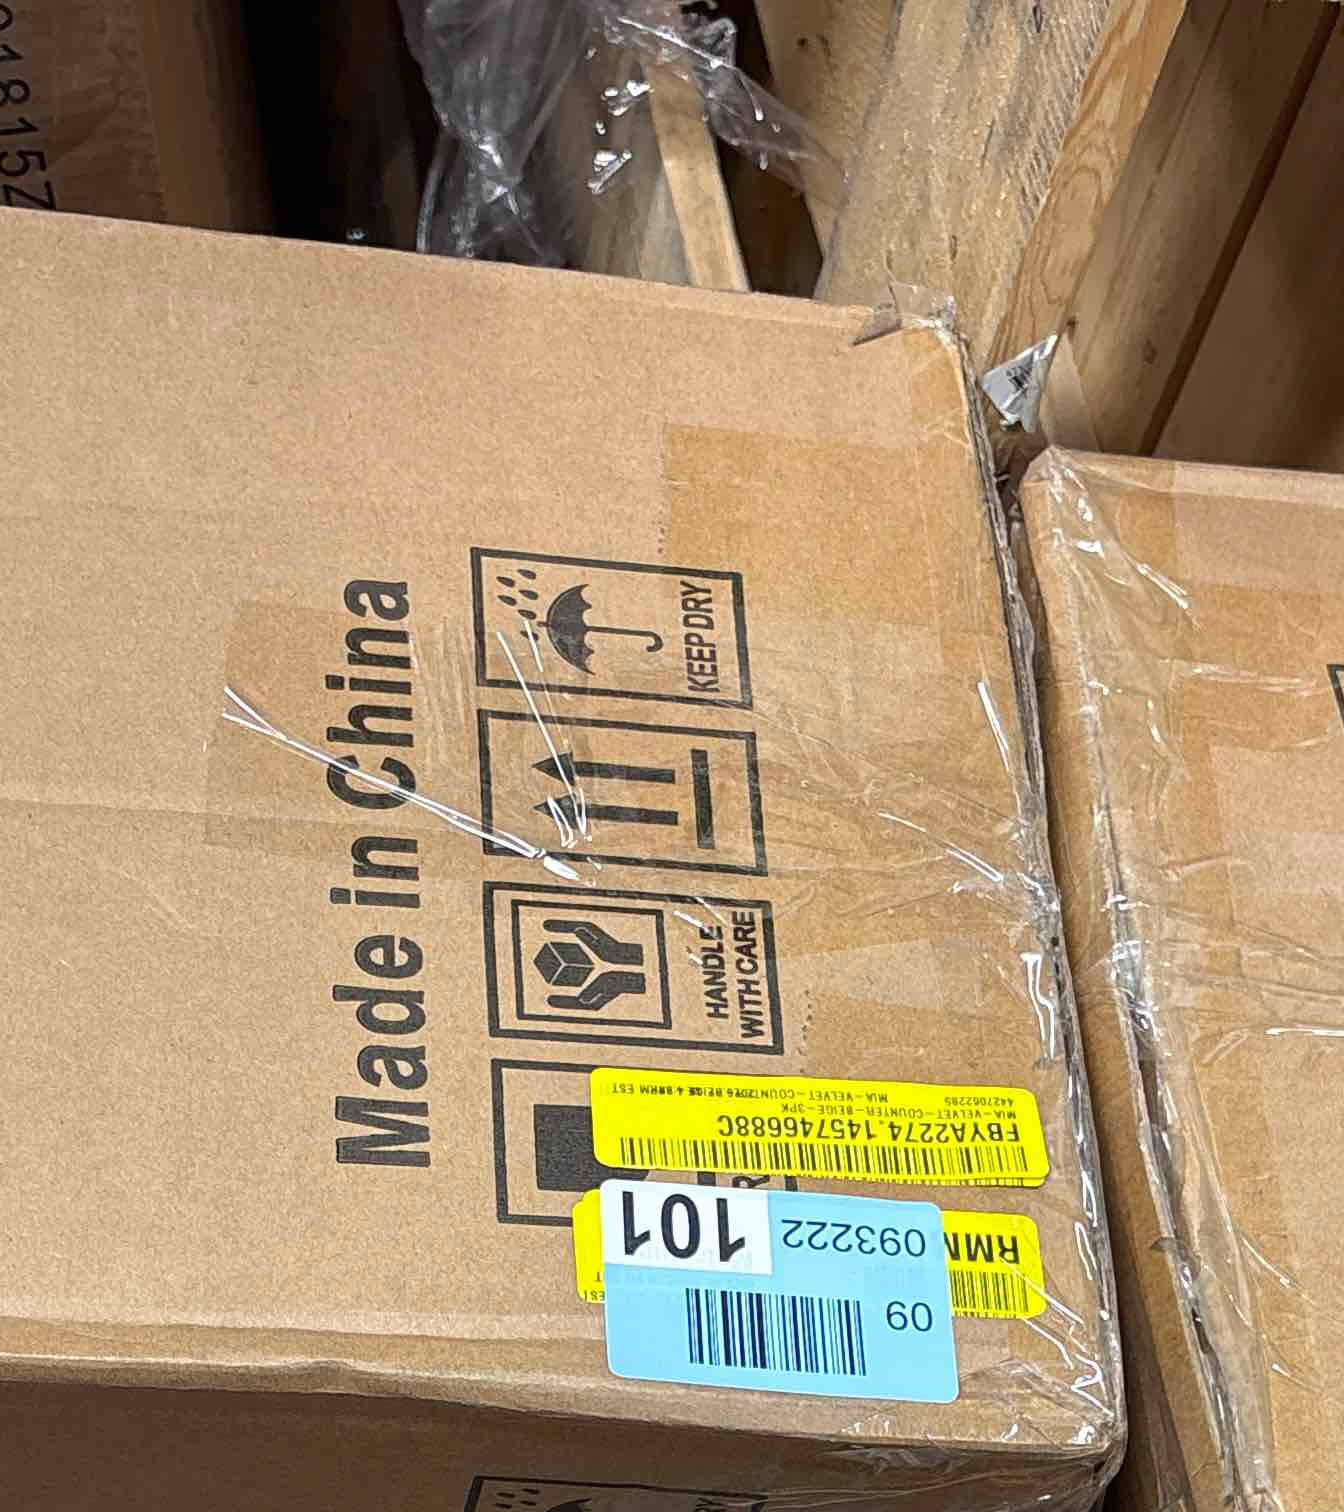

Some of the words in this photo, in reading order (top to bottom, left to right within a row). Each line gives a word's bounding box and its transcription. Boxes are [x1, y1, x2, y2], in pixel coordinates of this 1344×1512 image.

[679, 580, 714, 630] DRY
[325, 577, 413, 810] China
[685, 633, 721, 694] KEEP
[330, 833, 424, 907] in
[706, 925, 731, 1020] HANDLE
[731, 910, 758, 971] CARE
[739, 970, 766, 1040] WITH
[332, 930, 432, 1168] Made
[717, 1113, 1021, 1144] FBYA2274.145746688C
[622, 1190, 746, 1263] 101
[782, 1218, 927, 1258] 093222
[886, 1301, 933, 1333] 09
